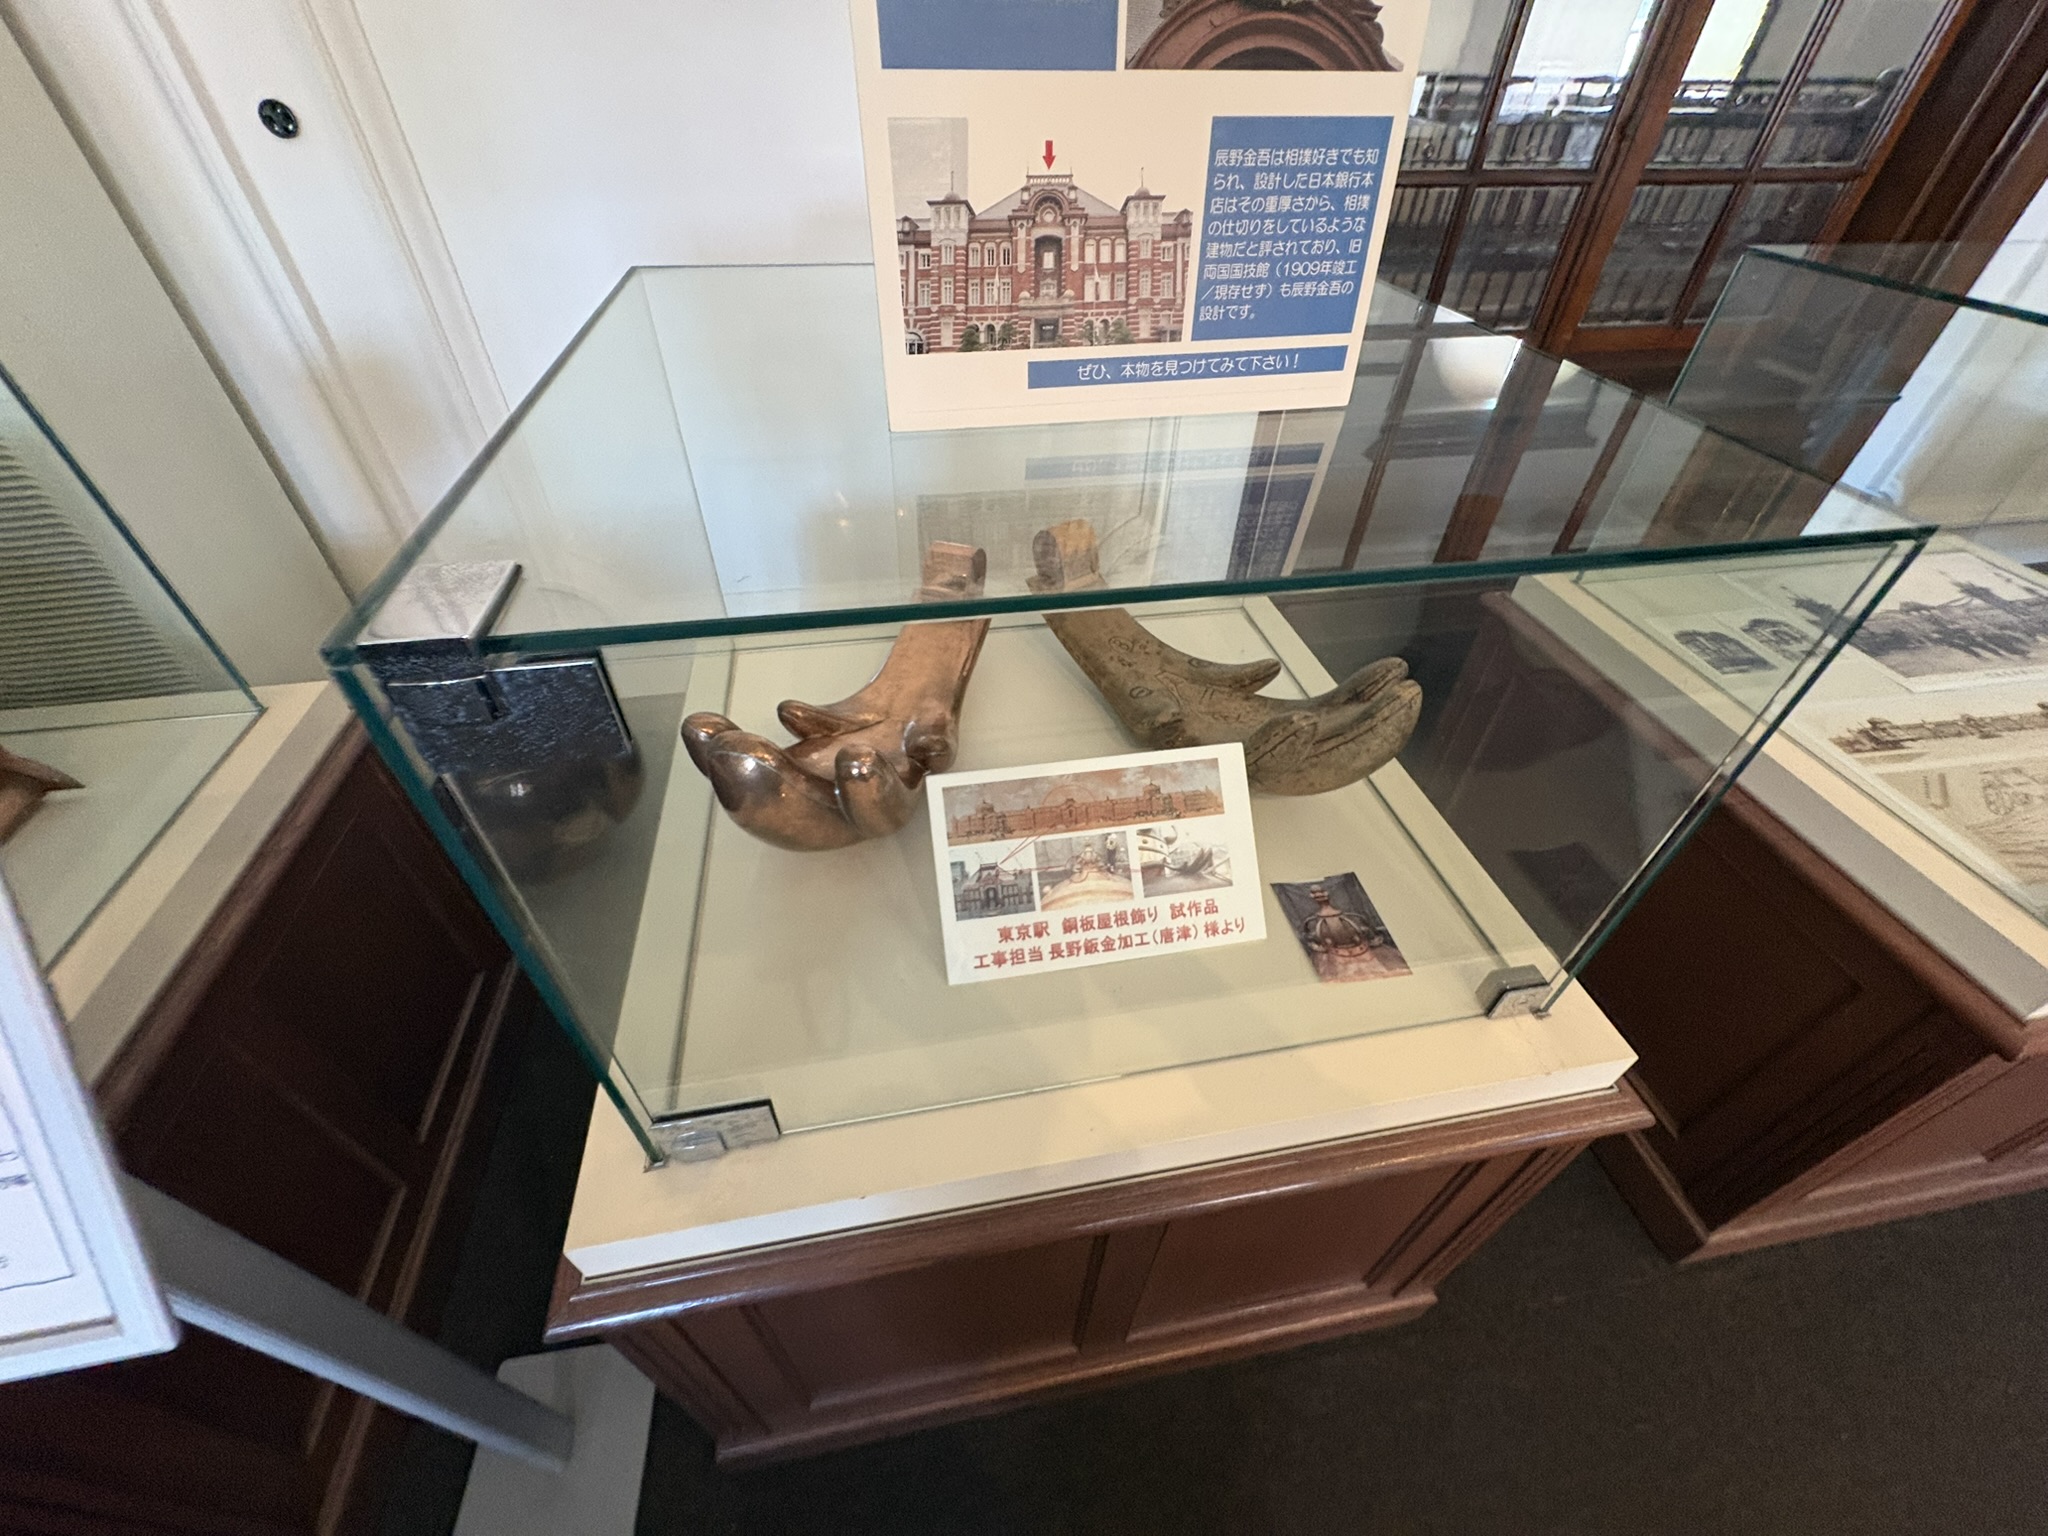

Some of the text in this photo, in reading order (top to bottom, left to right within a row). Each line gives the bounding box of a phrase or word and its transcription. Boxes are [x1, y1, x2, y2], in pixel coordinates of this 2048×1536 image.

[1215, 149, 1379, 167] 辰野金吾は相撲好きでも知
[1213, 172, 1375, 191] られ、設計した日本銀行本
[1210, 195, 1371, 214] 店はその重厚さから、相撲
[1208, 217, 1366, 236] の仕切りをしているような
[1206, 239, 1362, 259] 建物だと評されており、旧
[1199, 304, 1255, 321] 設計です。
[997, 921, 1051, 943] 東京駅
[1169, 898, 1219, 920] 試作品
[973, 946, 1043, 969] 工事担当
[1203, 917, 1245, 938] 様より
